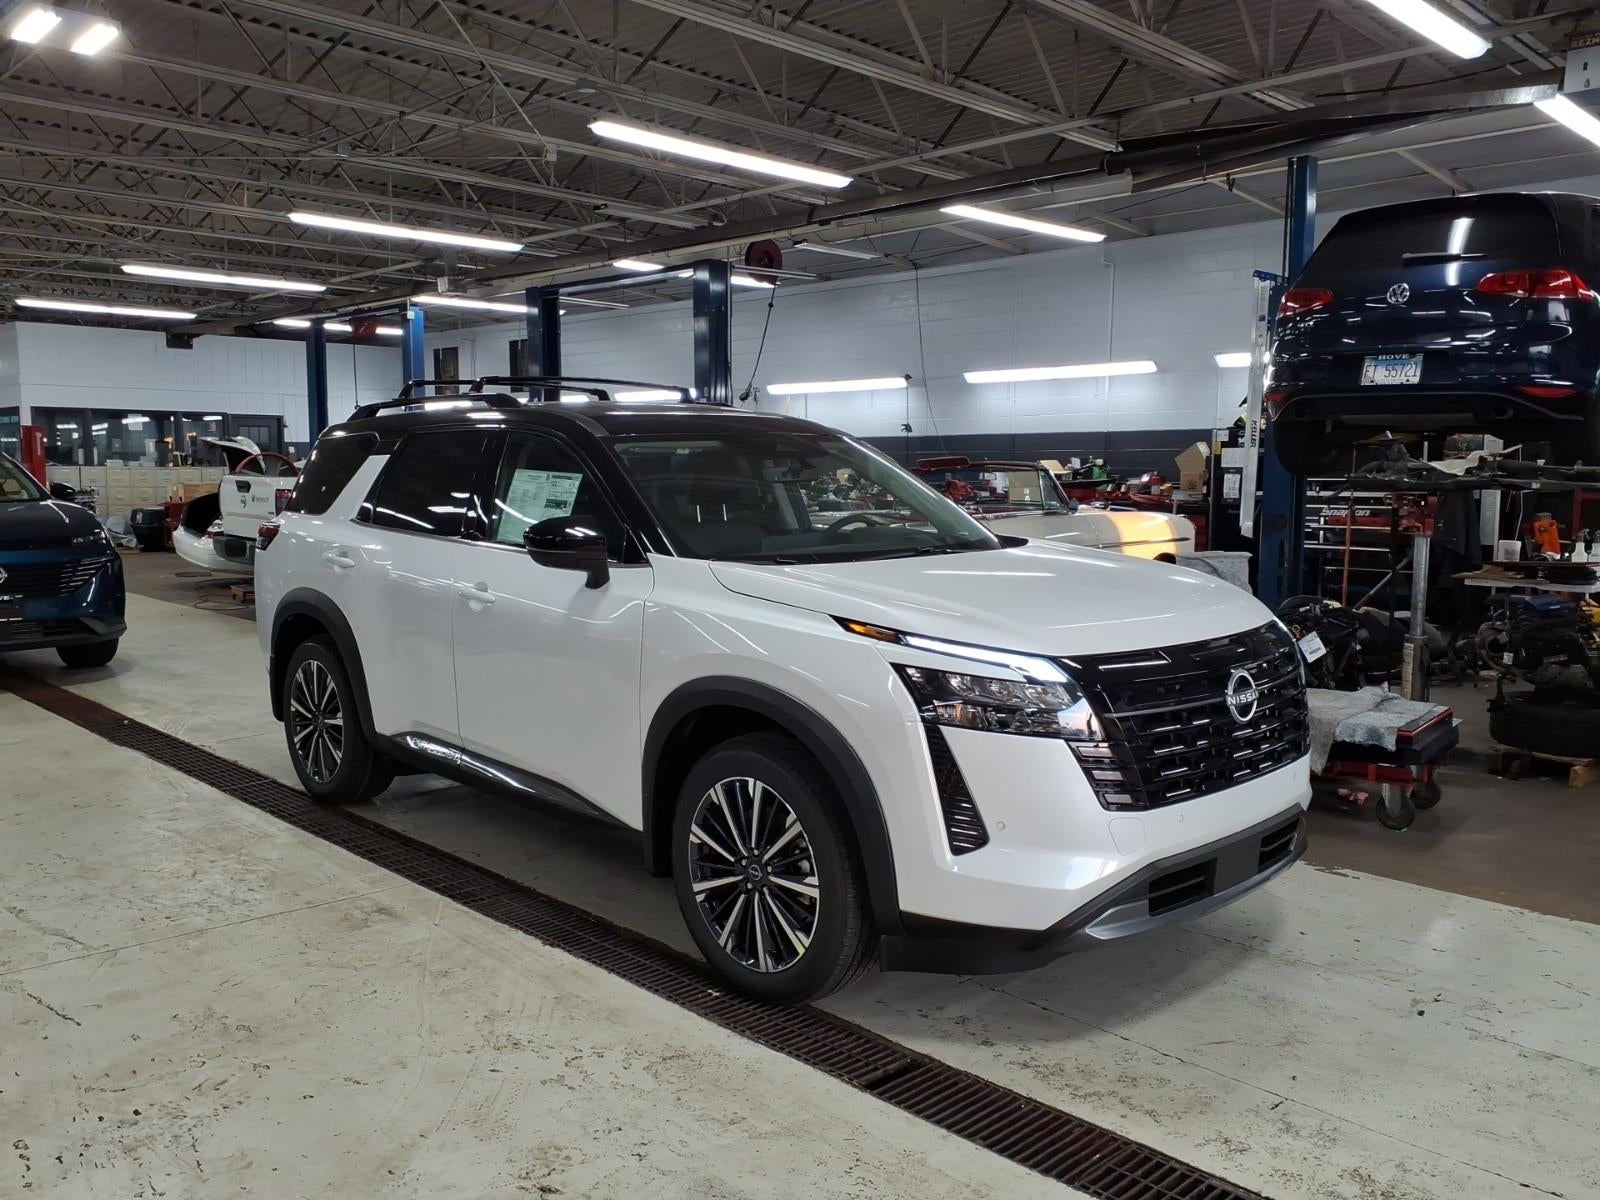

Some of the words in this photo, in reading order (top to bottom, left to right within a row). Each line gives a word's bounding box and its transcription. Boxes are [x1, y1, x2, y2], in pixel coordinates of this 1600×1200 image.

[1384, 362, 1418, 378] 55721
[1250, 420, 1258, 448] KELLER
[1320, 507, 1371, 518] Snapon
